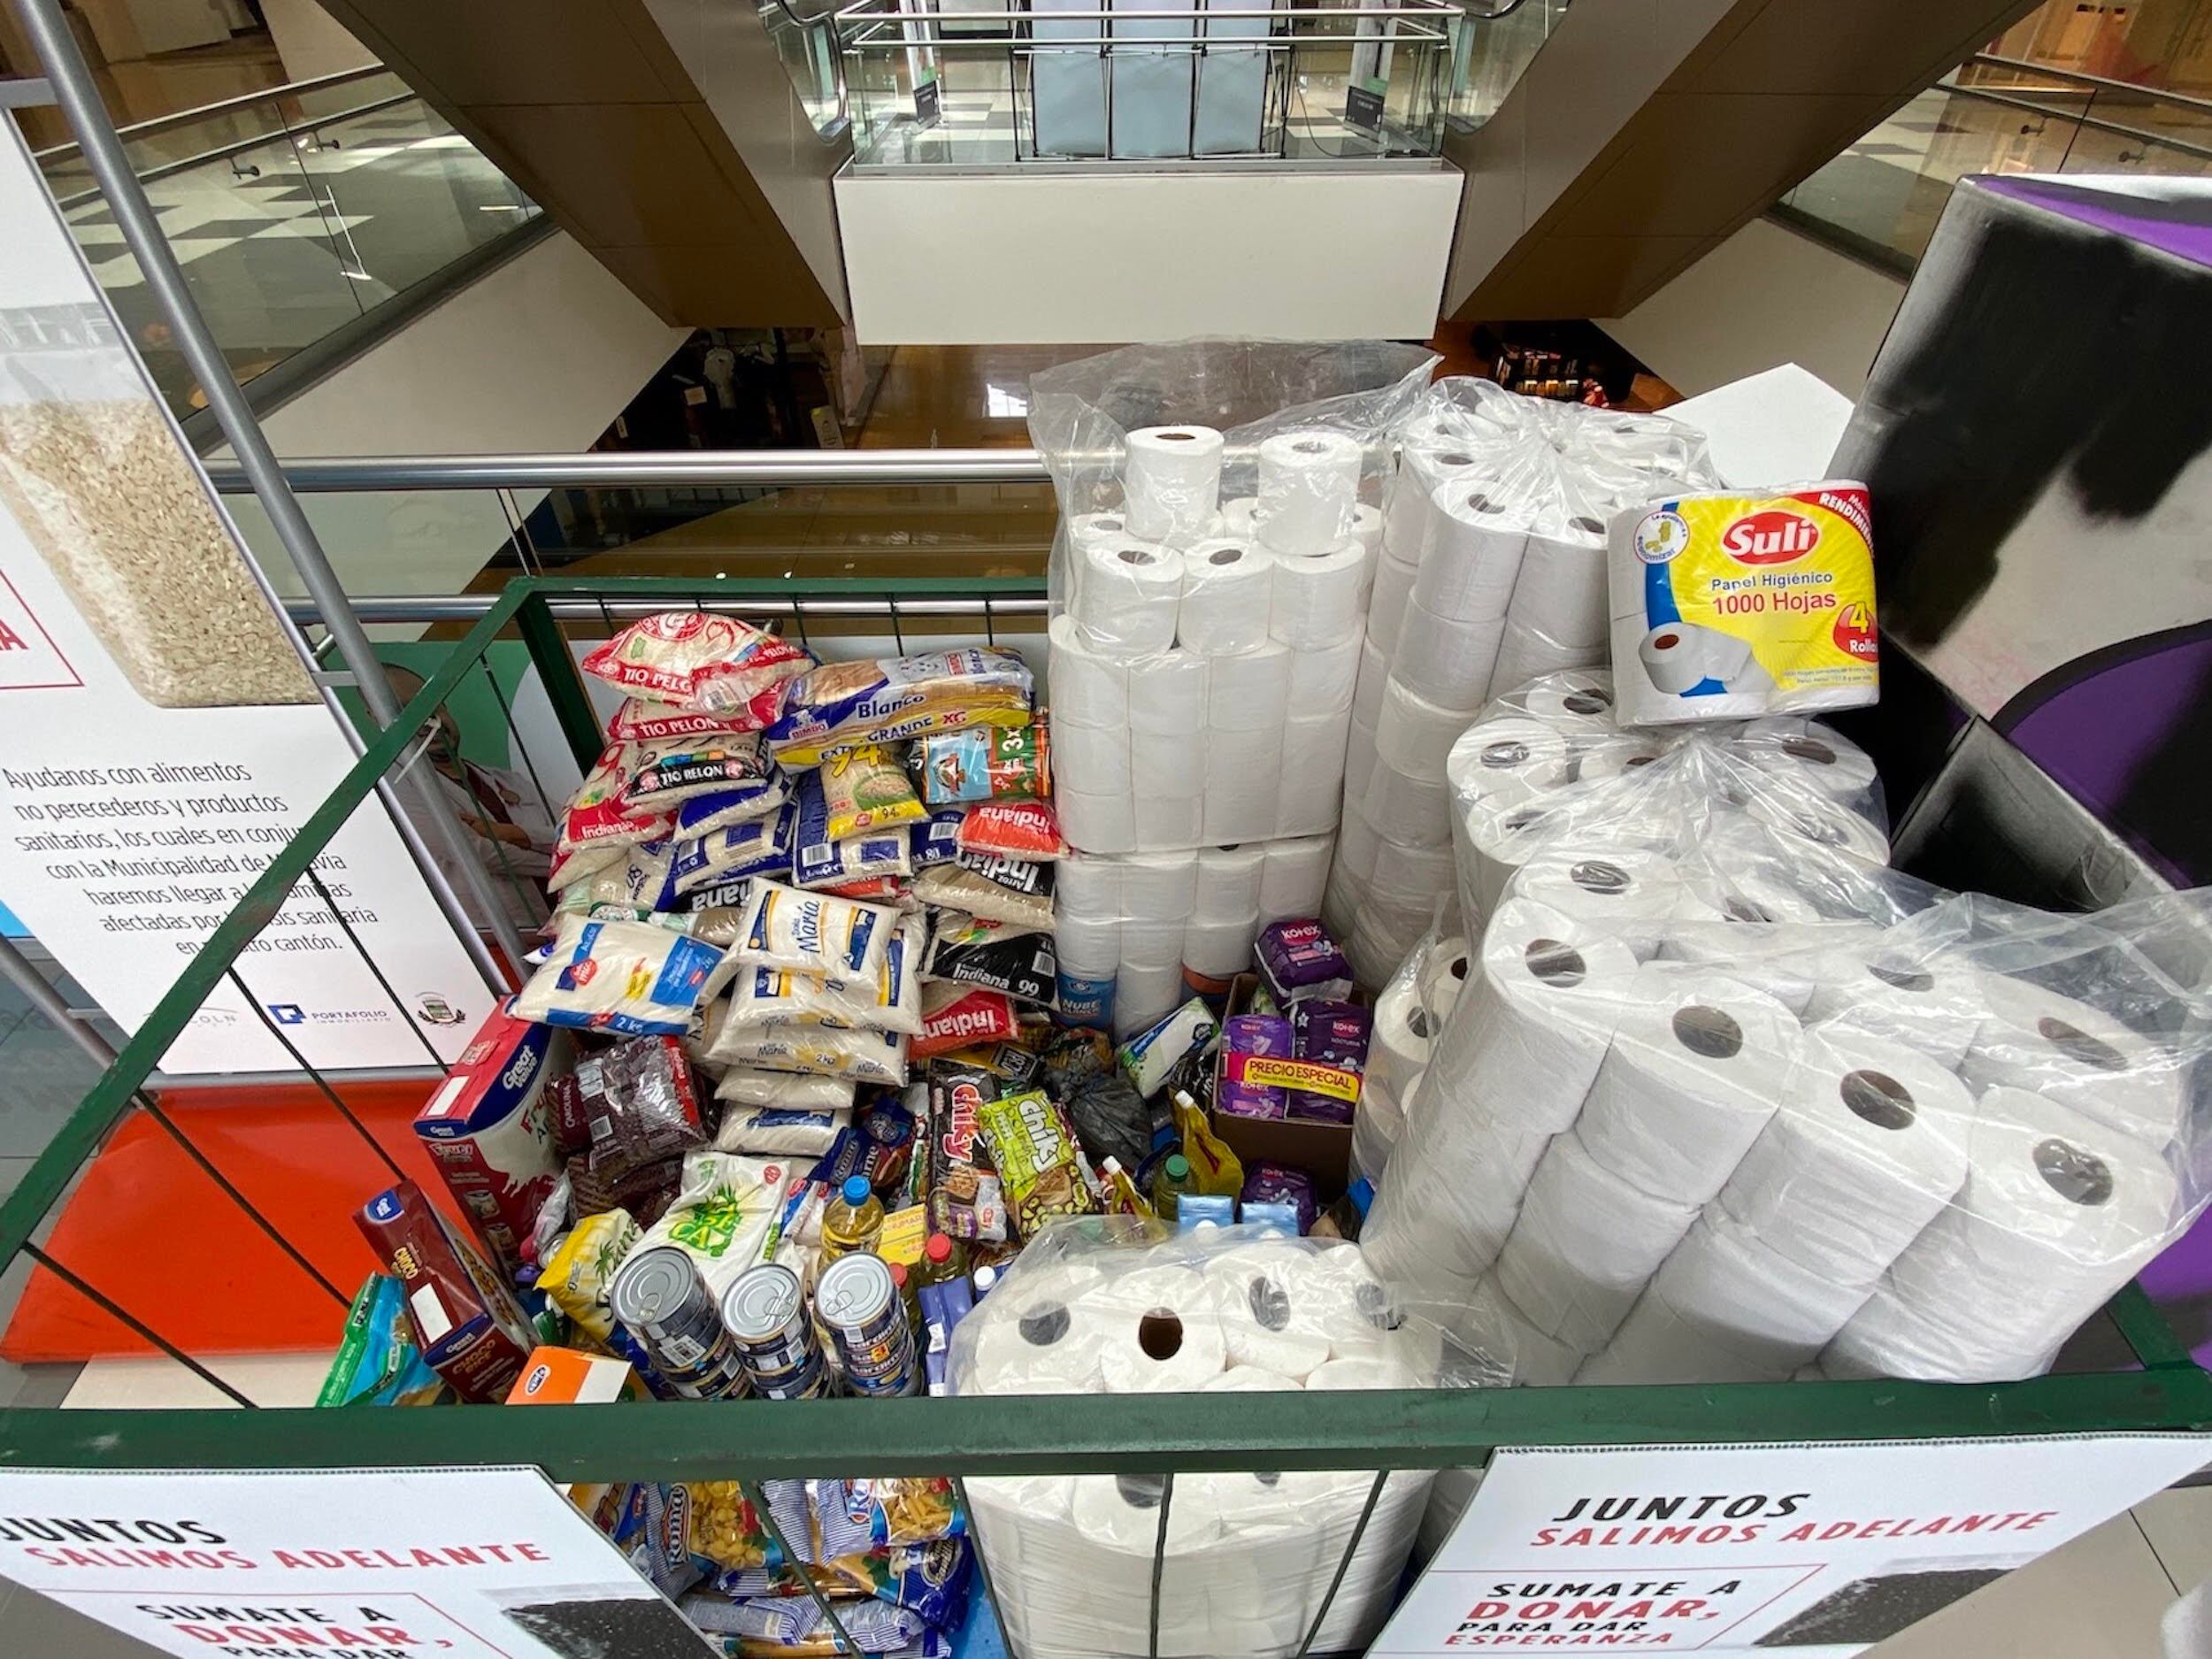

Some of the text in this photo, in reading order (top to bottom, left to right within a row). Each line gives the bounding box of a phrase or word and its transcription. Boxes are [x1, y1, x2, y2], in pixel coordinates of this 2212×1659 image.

[1724, 518, 1814, 557] Suli
[1712, 571, 1832, 592] Papel Higiénico
[1712, 591, 1837, 616] 1000 Hojas
[1849, 602, 1870, 634] 4
[623, 668, 648, 684] TIO
[857, 694, 925, 718] Blanco
[640, 717, 719, 737] TIO PELON
[867, 717, 933, 743] GRANDE
[941, 710, 967, 724] XG
[2, 761, 252, 791] Ayudanos con alimentos
[660, 769, 682, 787] TIO
[13, 794, 289, 823] no perecederos y productos
[14, 830, 121, 851] sanitarios,
[113, 827, 151, 847] los
[151, 826, 217, 847] cuales
[216, 827, 245, 844] en
[46, 863, 85, 879] con
[79, 859, 106, 878] la
[100, 854, 241, 879] Municipalidad
[240, 854, 266, 873] de
[82, 888, 173, 907] haremos
[167, 884, 228, 905] llegar
[98, 911, 192, 933] afectadas
[191, 912, 223, 932] por
[798, 899, 820, 955] María
[175, 939, 202, 956] en
[274, 933, 343, 954] cantón.
[953, 962, 1041, 997] Indiana 99
[311, 1010, 388, 1021] PORTAFOLIO
[502, 1045, 535, 1091] Great
[1249, 1060, 1352, 1090] PRECIO ESPECIAL
[1552, 1493, 1812, 1522] JUNTOS
[0, 1517, 227, 1545] JUNTOS
[1530, 1510, 2062, 1548] SALIMOS ADELANTE
[24, 1543, 551, 1570] SALIMOS ADELANTE
[1486, 1579, 1742, 1599] SUMATE A
[136, 1603, 395, 1624] SUMATE A
[1466, 1599, 1721, 1621] DONAR,
[171, 1624, 454, 1649] DONAR,
[1444, 1632, 1674, 1646] ESPERANZA
[1457, 1620, 1649, 1633] PARA DAR
